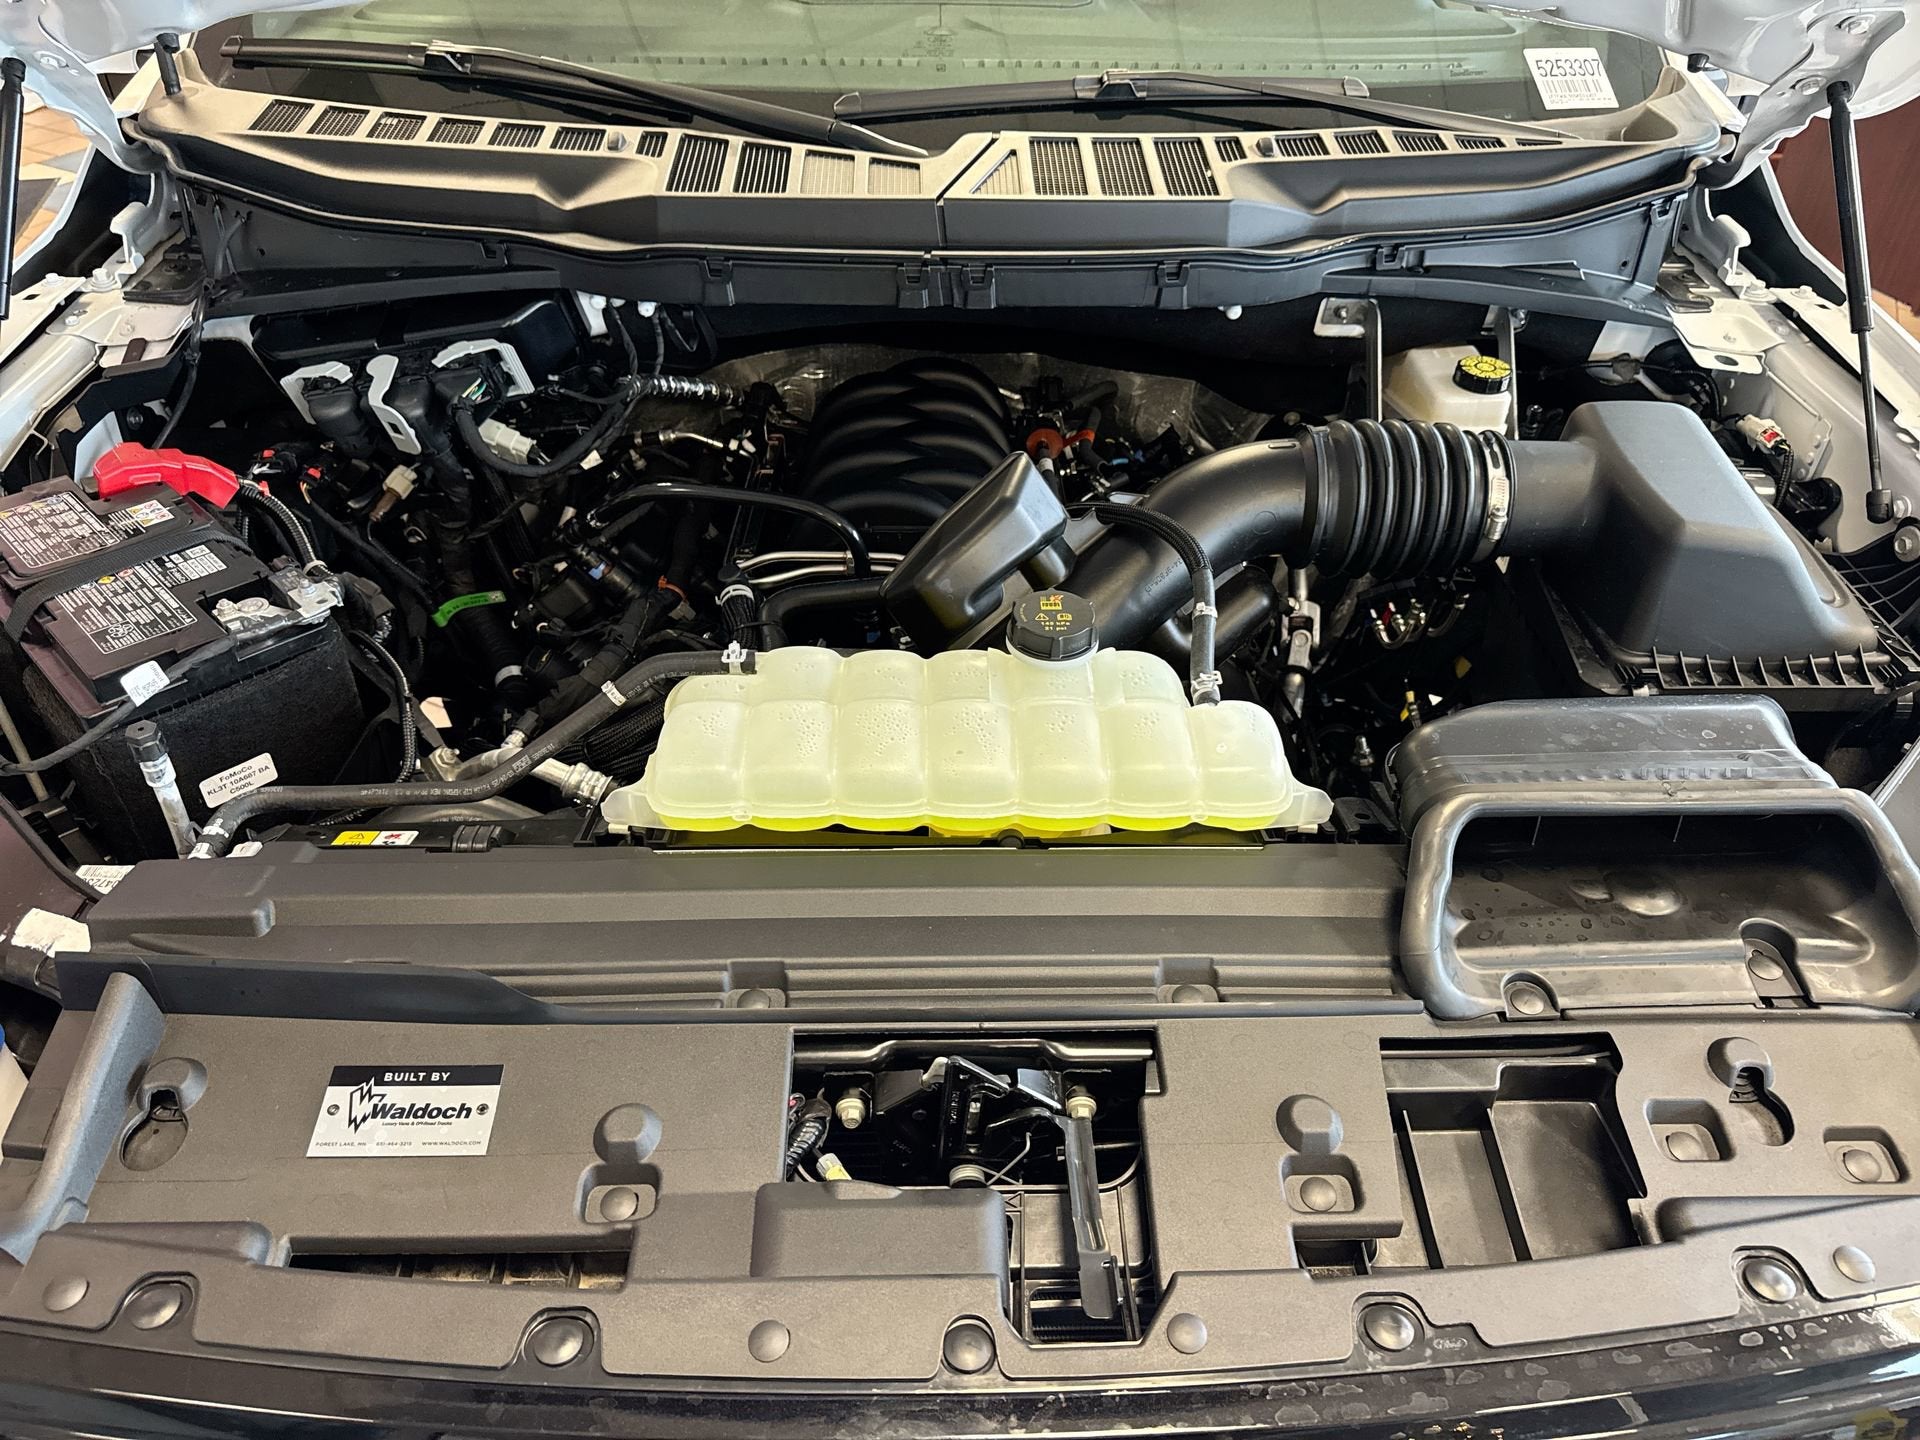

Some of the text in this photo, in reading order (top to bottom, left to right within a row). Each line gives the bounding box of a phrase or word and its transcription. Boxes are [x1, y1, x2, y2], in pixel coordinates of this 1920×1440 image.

[1535, 58, 1602, 78] 5253307
[207, 784, 228, 796] KL3T
[258, 765, 271, 774] BA
[219, 765, 253, 782] FoMoCo
[229, 781, 255, 794] C500L
[383, 1072, 451, 1082] BUILT BY
[370, 1103, 473, 1120] Waldoch
